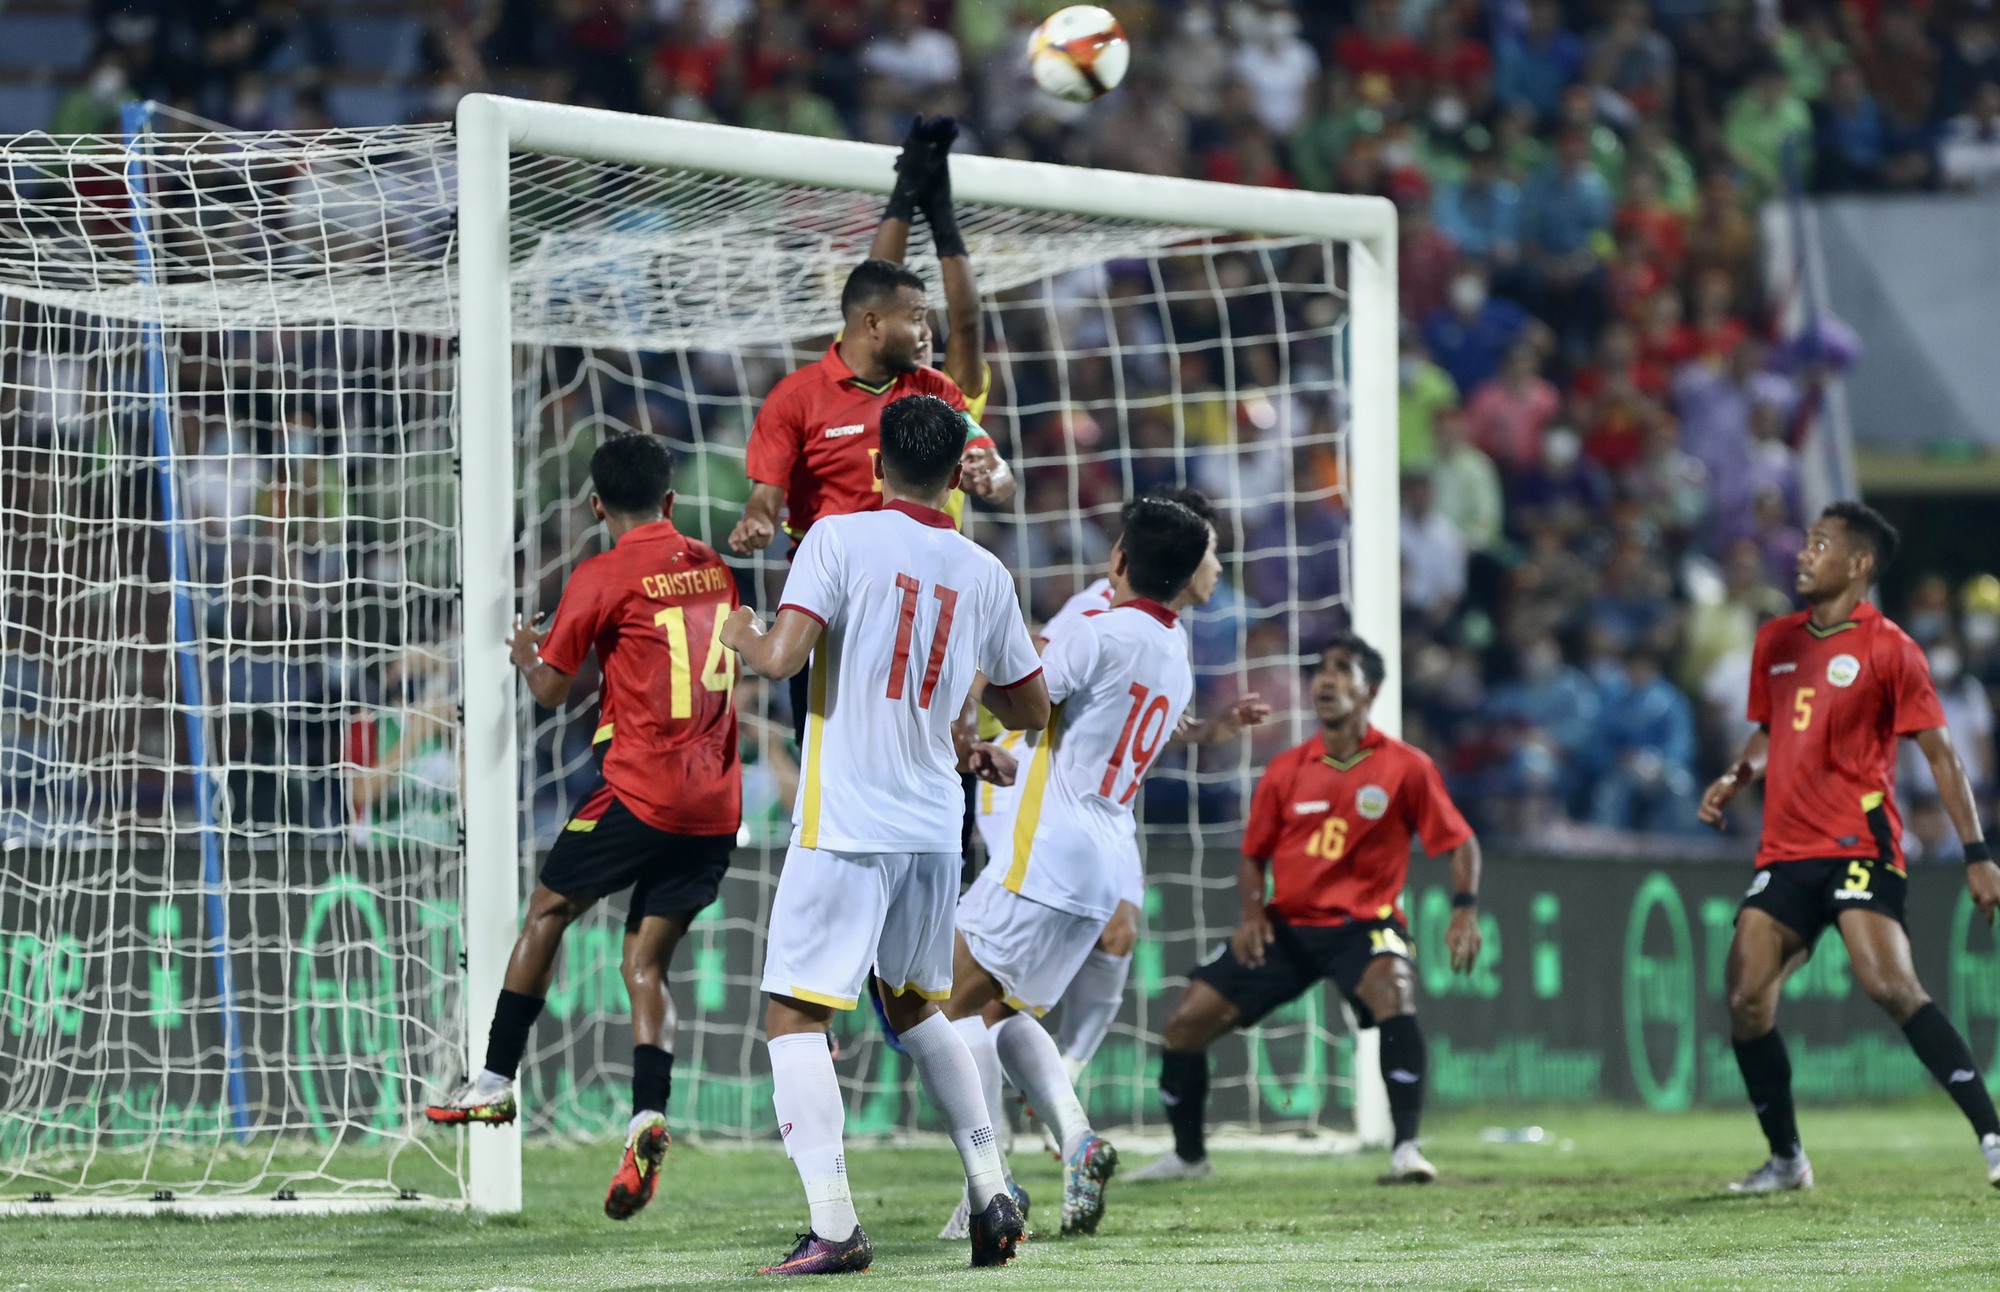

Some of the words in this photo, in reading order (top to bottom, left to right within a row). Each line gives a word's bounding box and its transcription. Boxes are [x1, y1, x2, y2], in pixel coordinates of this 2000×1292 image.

[654, 603, 735, 718] 14
[886, 572, 958, 709] 11
[1098, 682, 1170, 804] 19
[1792, 687, 1816, 731] 5
[1305, 817, 1348, 861] 16
[1844, 860, 1874, 891] 5
